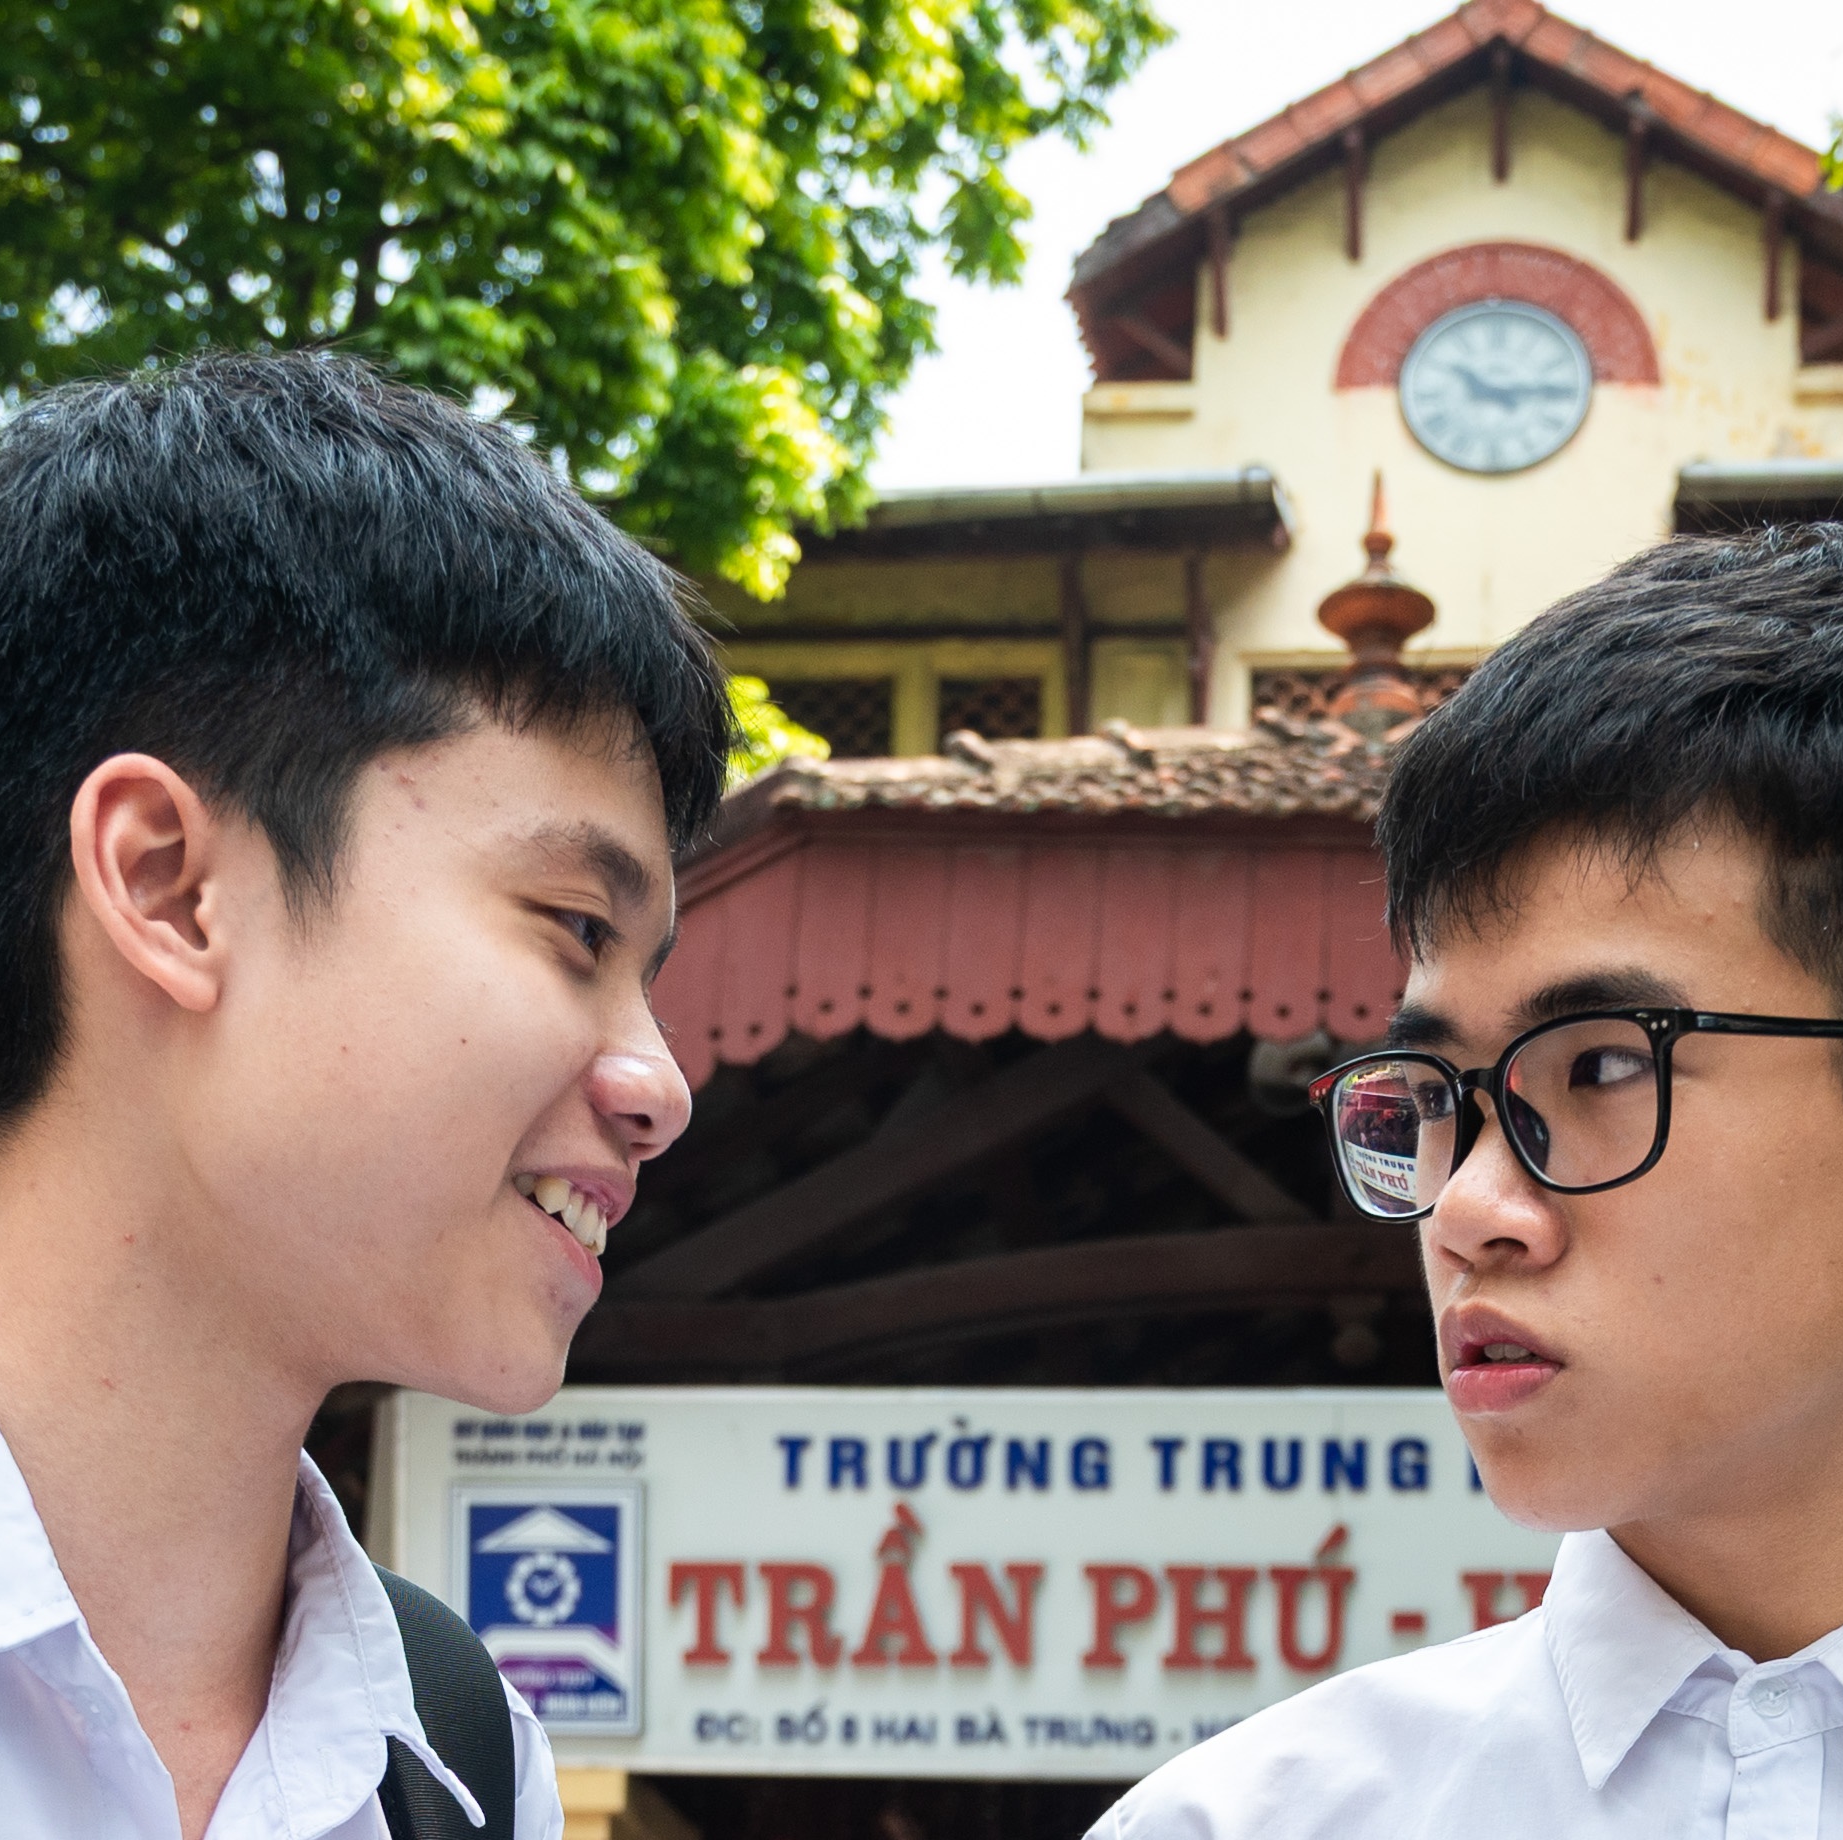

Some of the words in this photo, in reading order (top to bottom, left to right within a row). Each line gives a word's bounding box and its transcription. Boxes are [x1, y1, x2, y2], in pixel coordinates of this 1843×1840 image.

[775, 1415, 1111, 1491] TRƯỜNG
[1149, 1436, 1429, 1492] TRUNG
[669, 1501, 1045, 1669] TRẦN
[1080, 1524, 1359, 1674] PHÚ
[873, 1715, 939, 1745] HAI
[955, 1706, 1009, 1746] BÀ
[1023, 1714, 1157, 1748] TRƯNG
